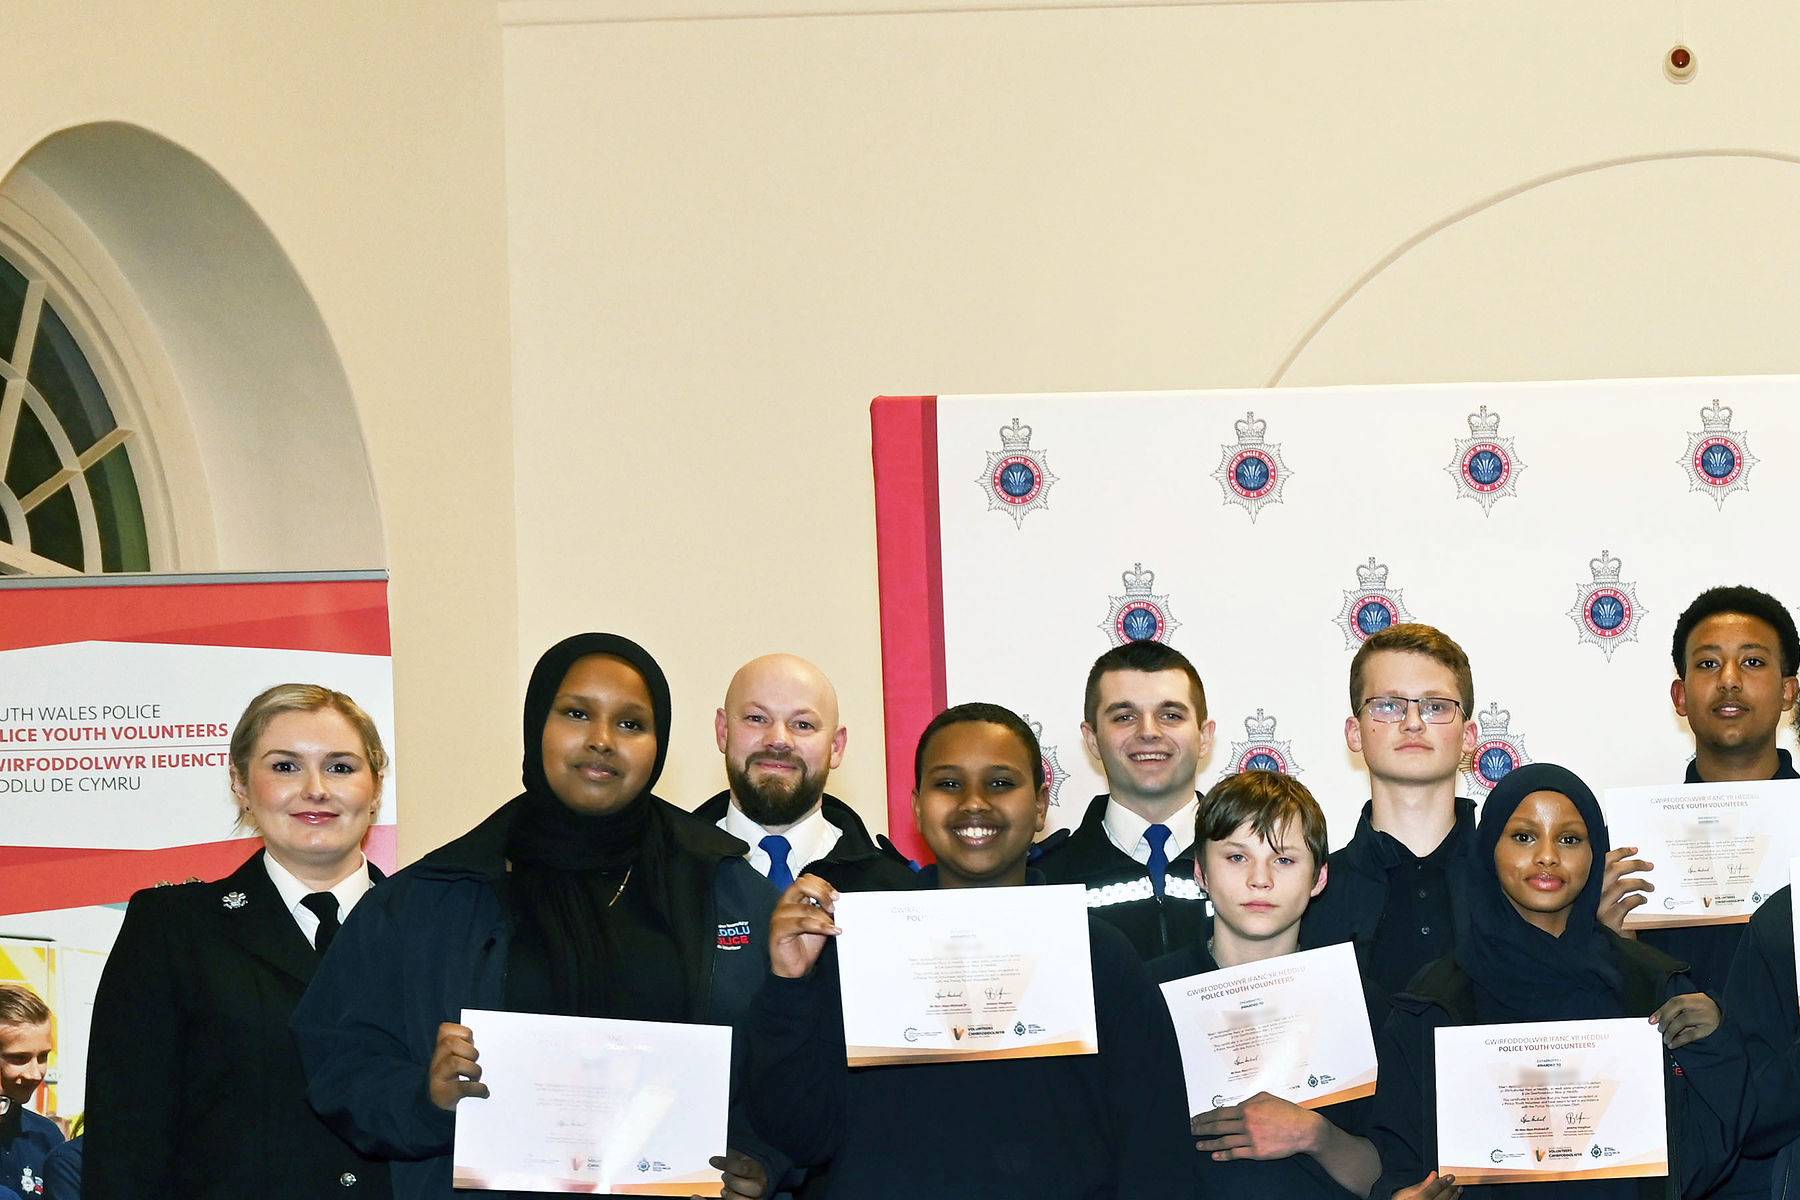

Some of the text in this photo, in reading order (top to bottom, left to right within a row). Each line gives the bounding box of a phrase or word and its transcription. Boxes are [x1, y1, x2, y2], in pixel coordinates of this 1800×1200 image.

[0, 704, 160, 722] UTH WALES POLICE
[0, 723, 229, 742] LICE YOUTH VOLUNTEERS
[152, 753, 230, 768] IEUENCT
[0, 776, 141, 793] DDLU DE CYMRU
[718, 926, 750, 937] DDLU
[1201, 990, 1224, 1001] POLICE
[1225, 985, 1249, 996] YOUTH
[1550, 1042, 1596, 1050] VOLUNTEERS
